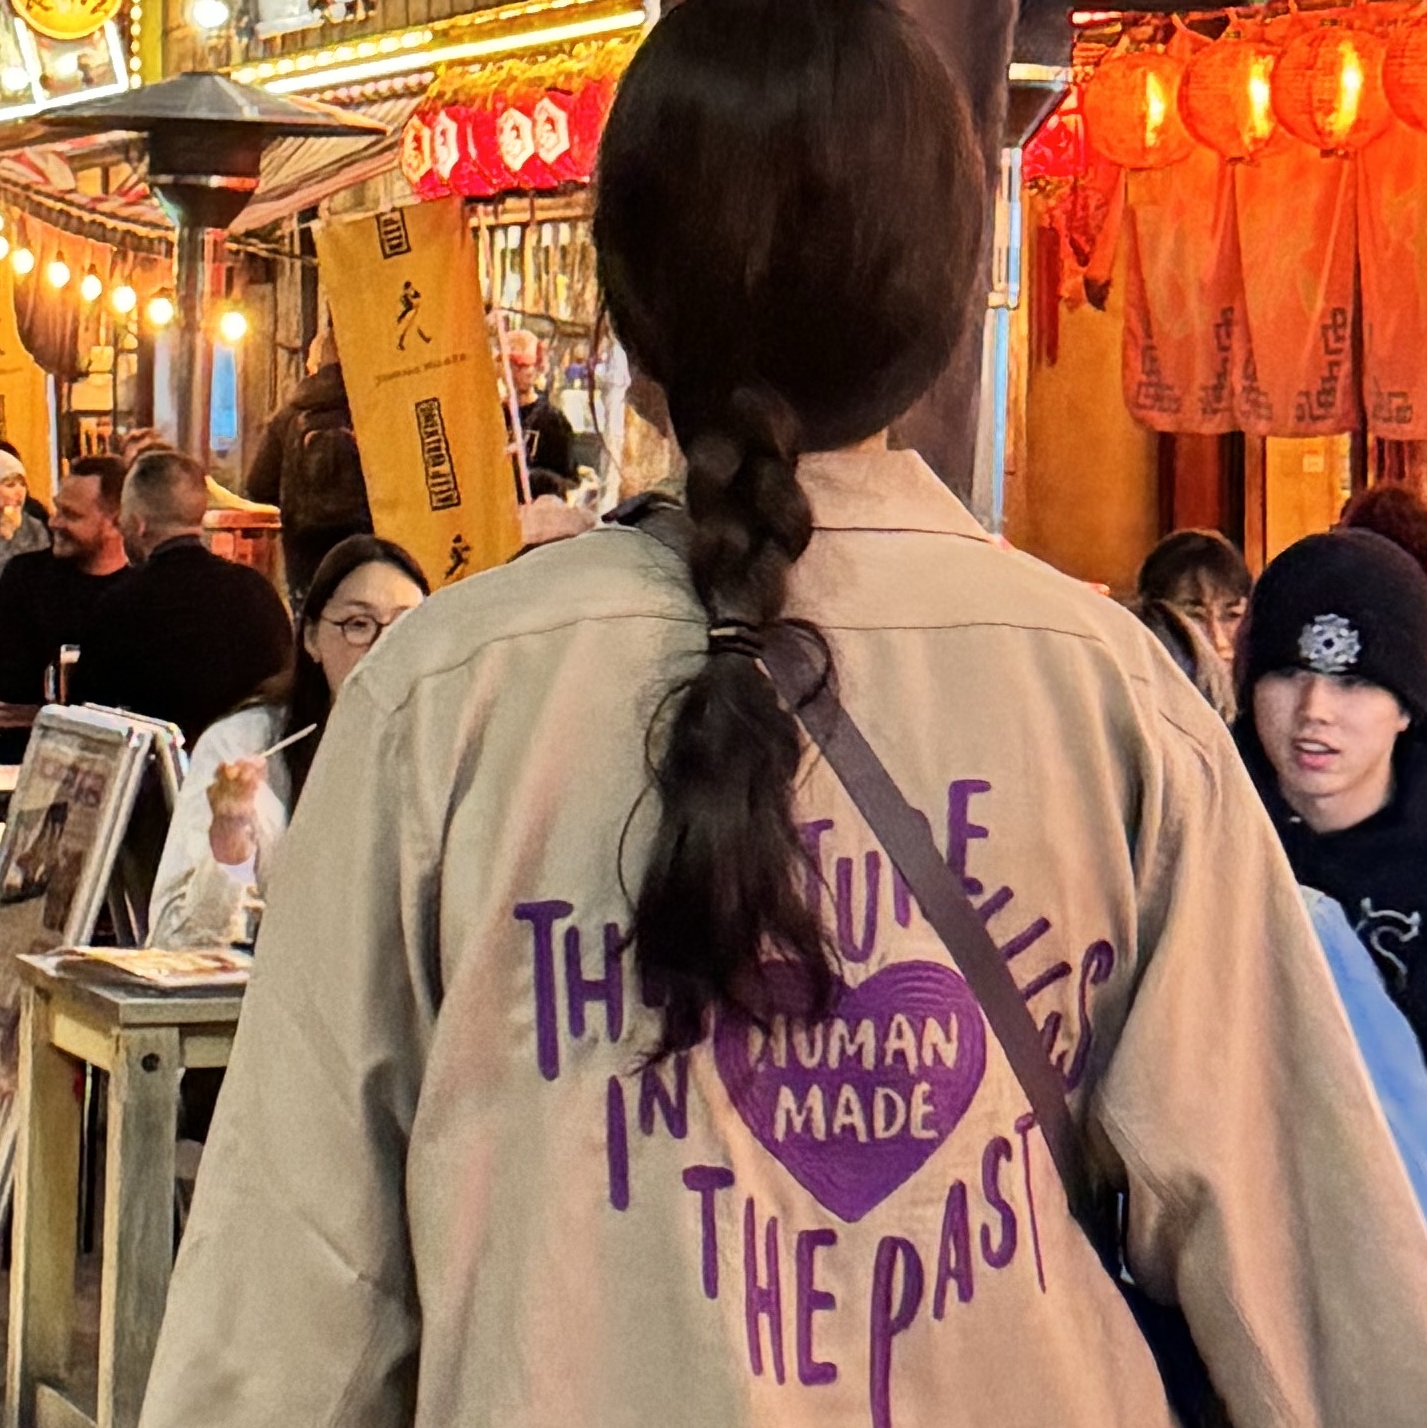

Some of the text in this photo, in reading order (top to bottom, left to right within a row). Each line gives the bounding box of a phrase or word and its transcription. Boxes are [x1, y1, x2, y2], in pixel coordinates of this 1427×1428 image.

[775, 1081, 941, 1143] MADE
[606, 1052, 690, 1213] IN
[682, 1165, 839, 1387] THE
